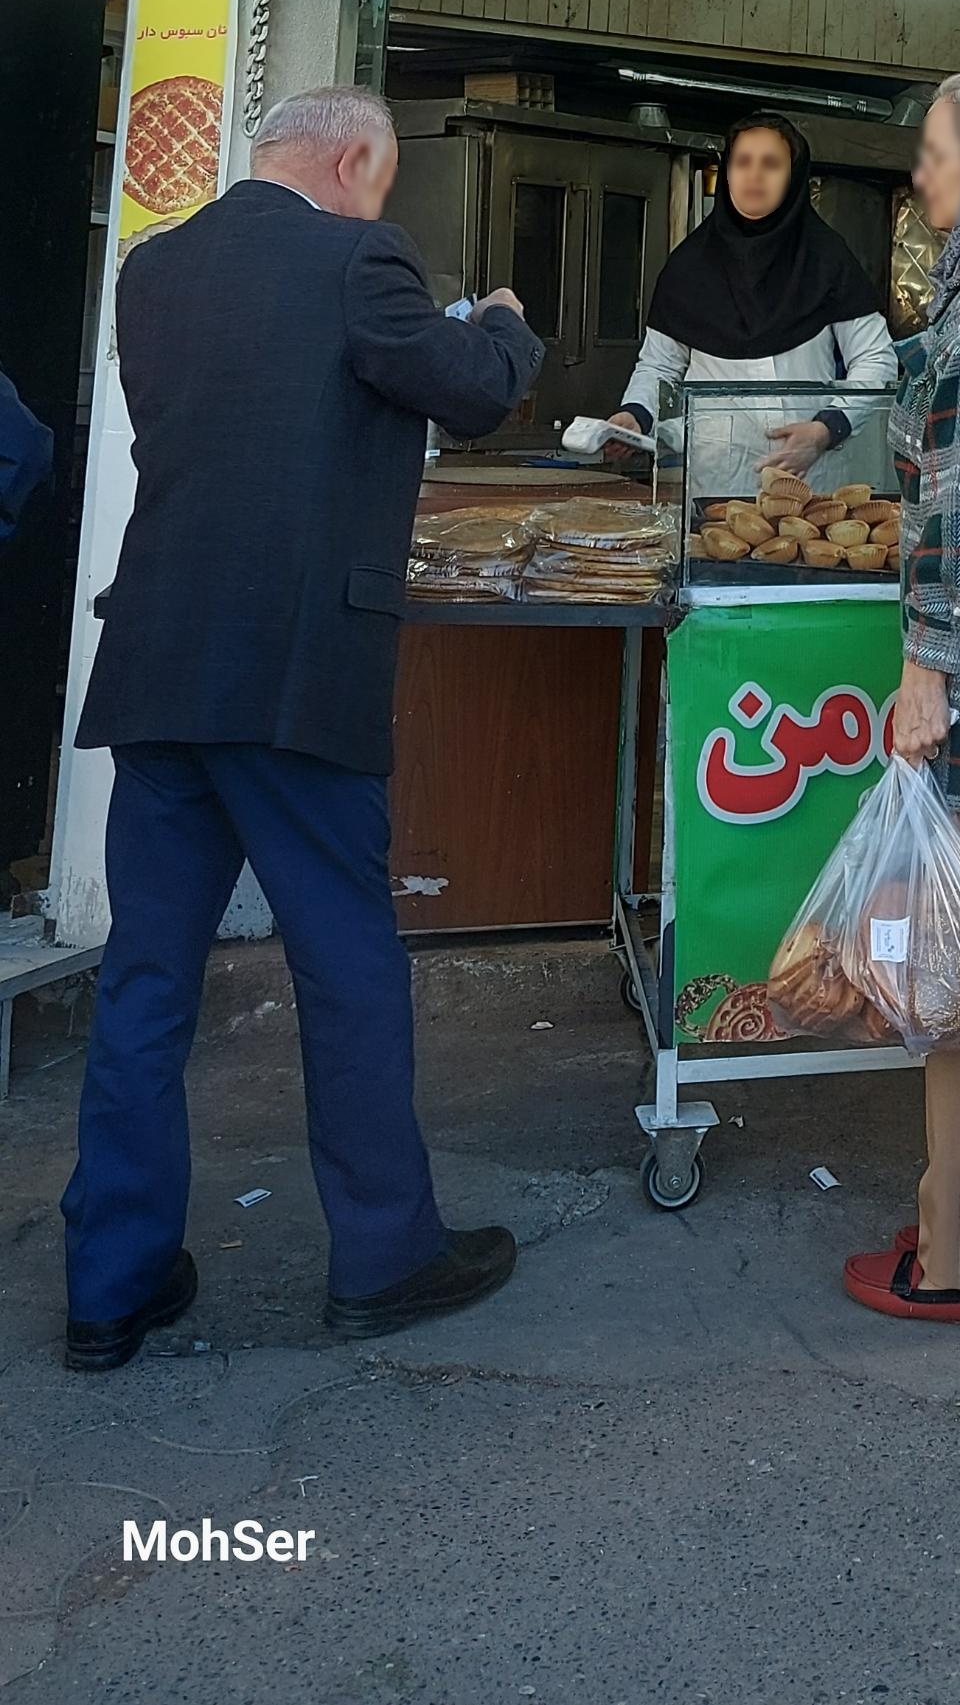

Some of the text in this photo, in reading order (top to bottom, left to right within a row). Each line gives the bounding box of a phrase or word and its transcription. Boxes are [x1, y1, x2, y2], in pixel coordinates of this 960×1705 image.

[136, 24, 229, 40] نان سبوس دار
